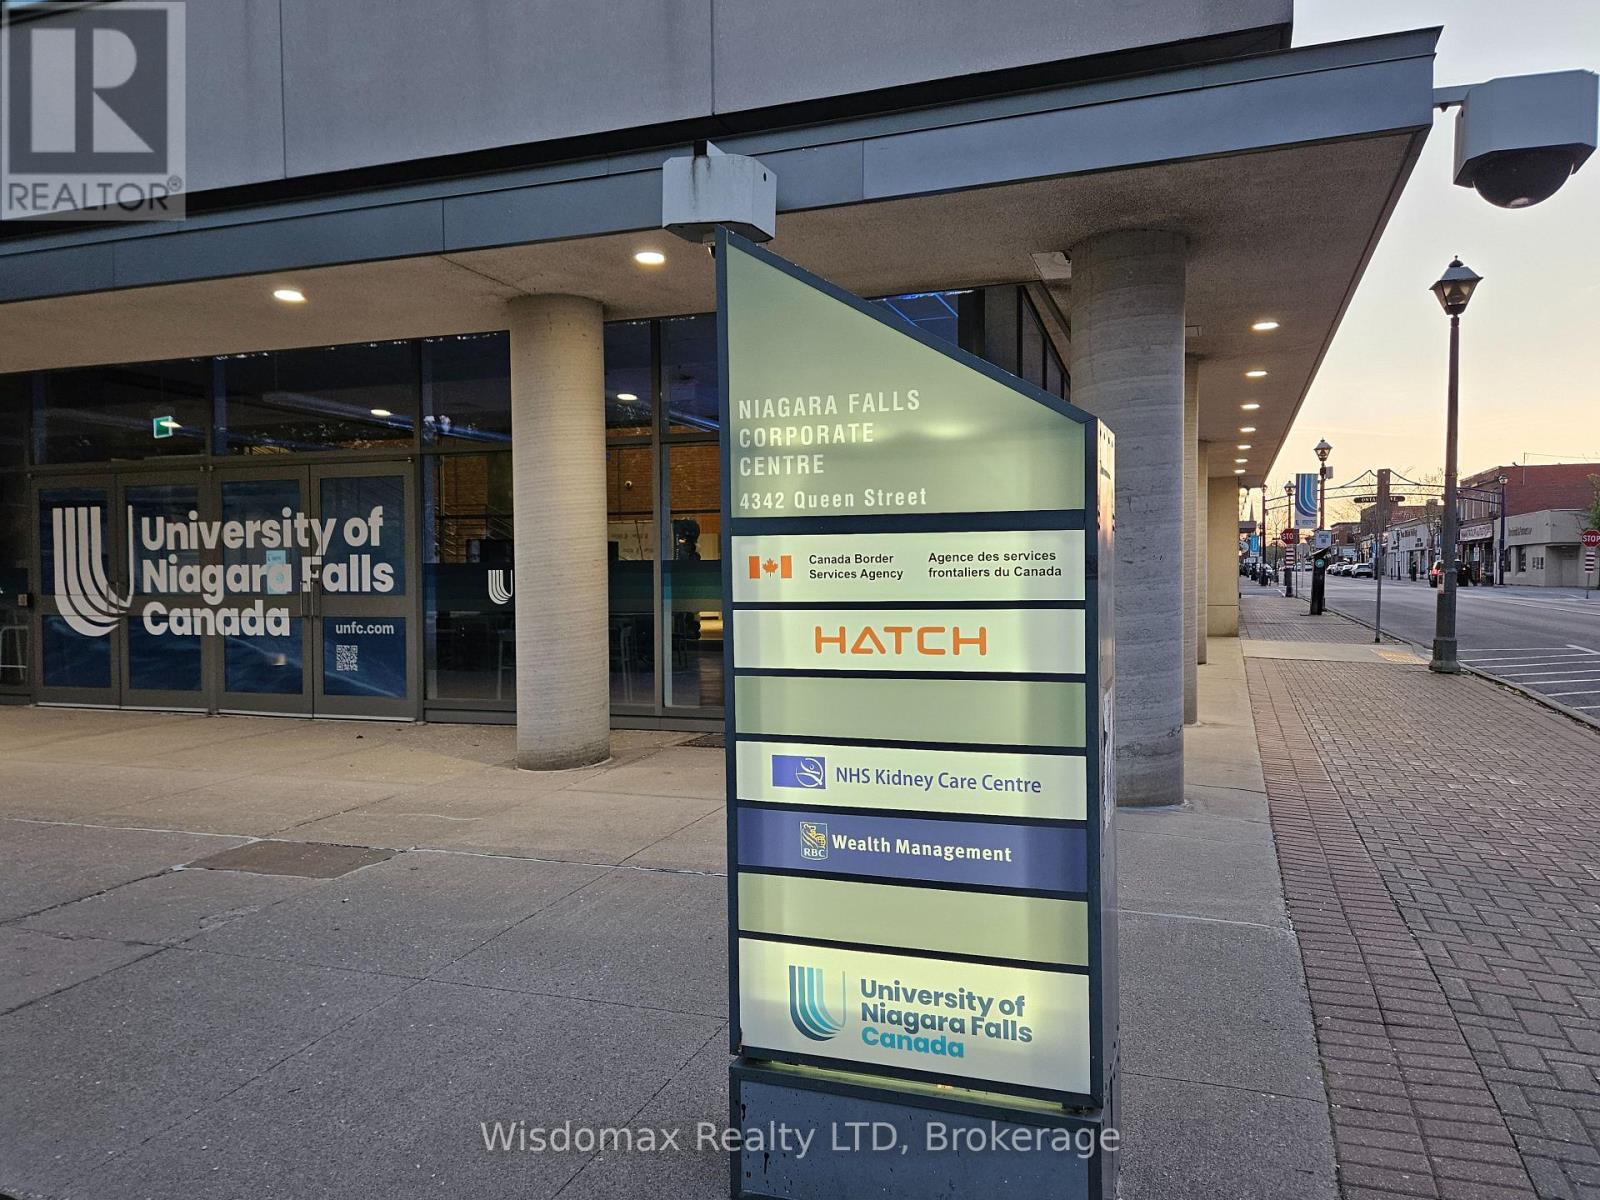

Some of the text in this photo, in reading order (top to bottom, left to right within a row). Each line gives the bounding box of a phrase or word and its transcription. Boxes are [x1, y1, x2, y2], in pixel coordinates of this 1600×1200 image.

[739, 389, 920, 420] NIAGARA FALLS
[739, 422, 875, 448] CORPORATE
[739, 454, 825, 477] CENTRE
[739, 488, 927, 510] 4342 Queen Street
[141, 505, 384, 556] University of
[1282, 532, 1294, 540] STO
[1582, 535, 1600, 543] STOP
[809, 553, 894, 565] Canada Border
[928, 551, 1056, 565] Agence des services
[142, 554, 394, 605] Niagara Falls
[809, 568, 904, 581] Services Agency
[928, 566, 1062, 578] frontaliers du Canada
[142, 600, 291, 637] Canada
[335, 622, 394, 635] unfc.com
[815, 626, 987, 656] HATCH
[835, 767, 1042, 793] NHS Kidney Care Centre
[803, 848, 826, 858] RBC
[832, 834, 1012, 863] Wealth Management
[860, 979, 1025, 1018] University of
[861, 1002, 1033, 1043] Niagara Falls
[861, 1026, 965, 1058] Canada
